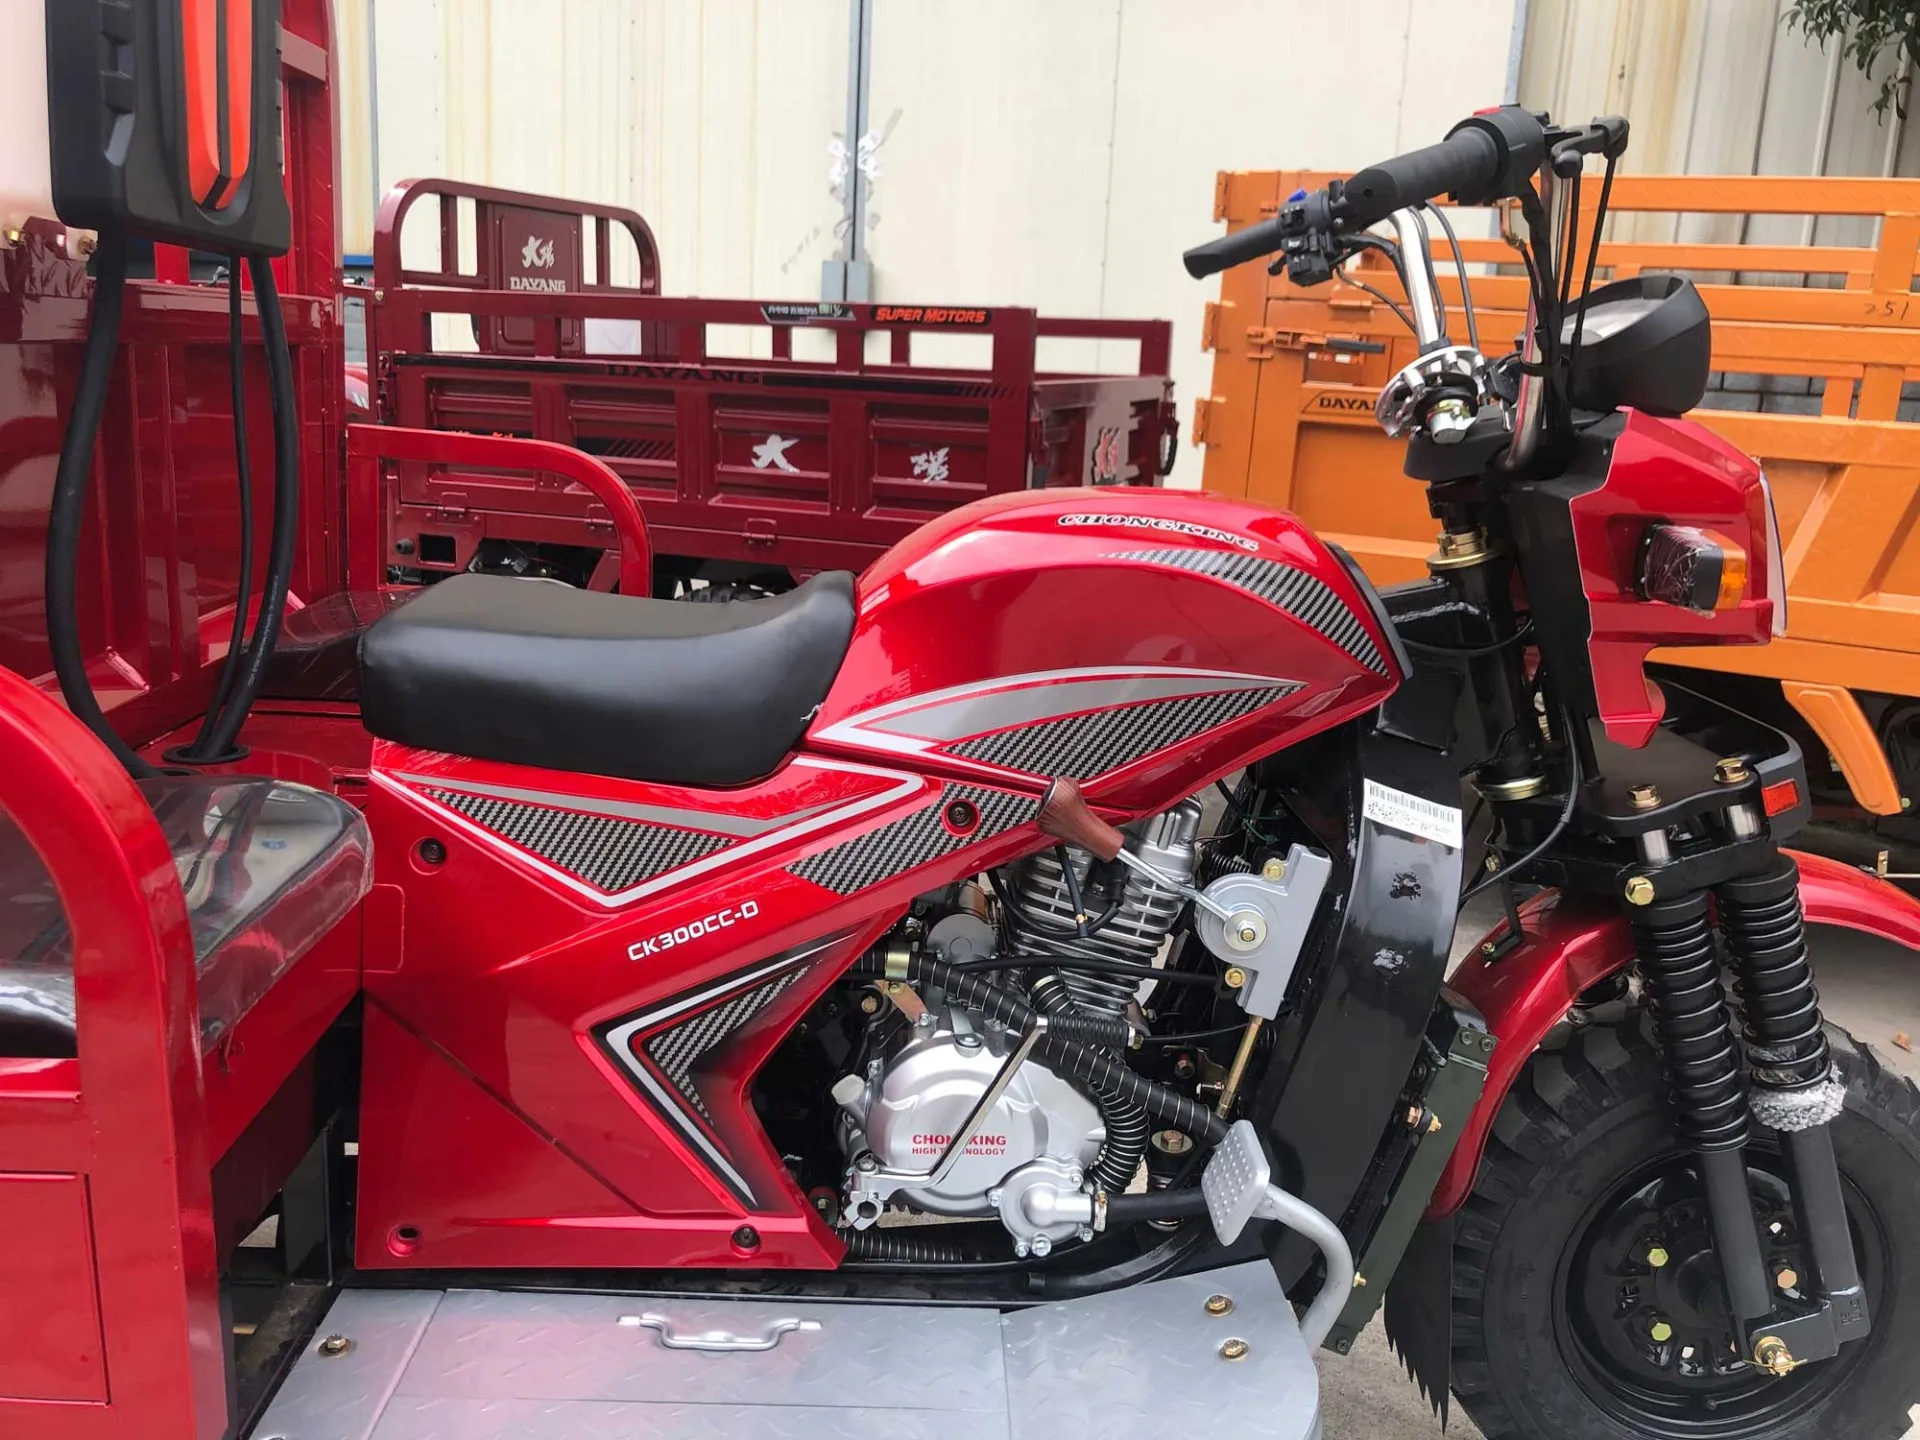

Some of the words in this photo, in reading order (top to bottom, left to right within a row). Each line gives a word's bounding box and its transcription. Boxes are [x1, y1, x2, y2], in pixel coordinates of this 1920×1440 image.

[510, 276, 566, 293] DAYANG
[875, 306, 923, 322] SUPER
[923, 308, 986, 324] MOTORS
[608, 365, 760, 386] DAYANG
[1320, 397, 1378, 411] DAYA
[1058, 514, 1260, 551] CHONGKING
[627, 900, 759, 961] CK300CC-D
[912, 1134, 1007, 1146] CHONKING
[912, 1147, 937, 1155] HIGH
